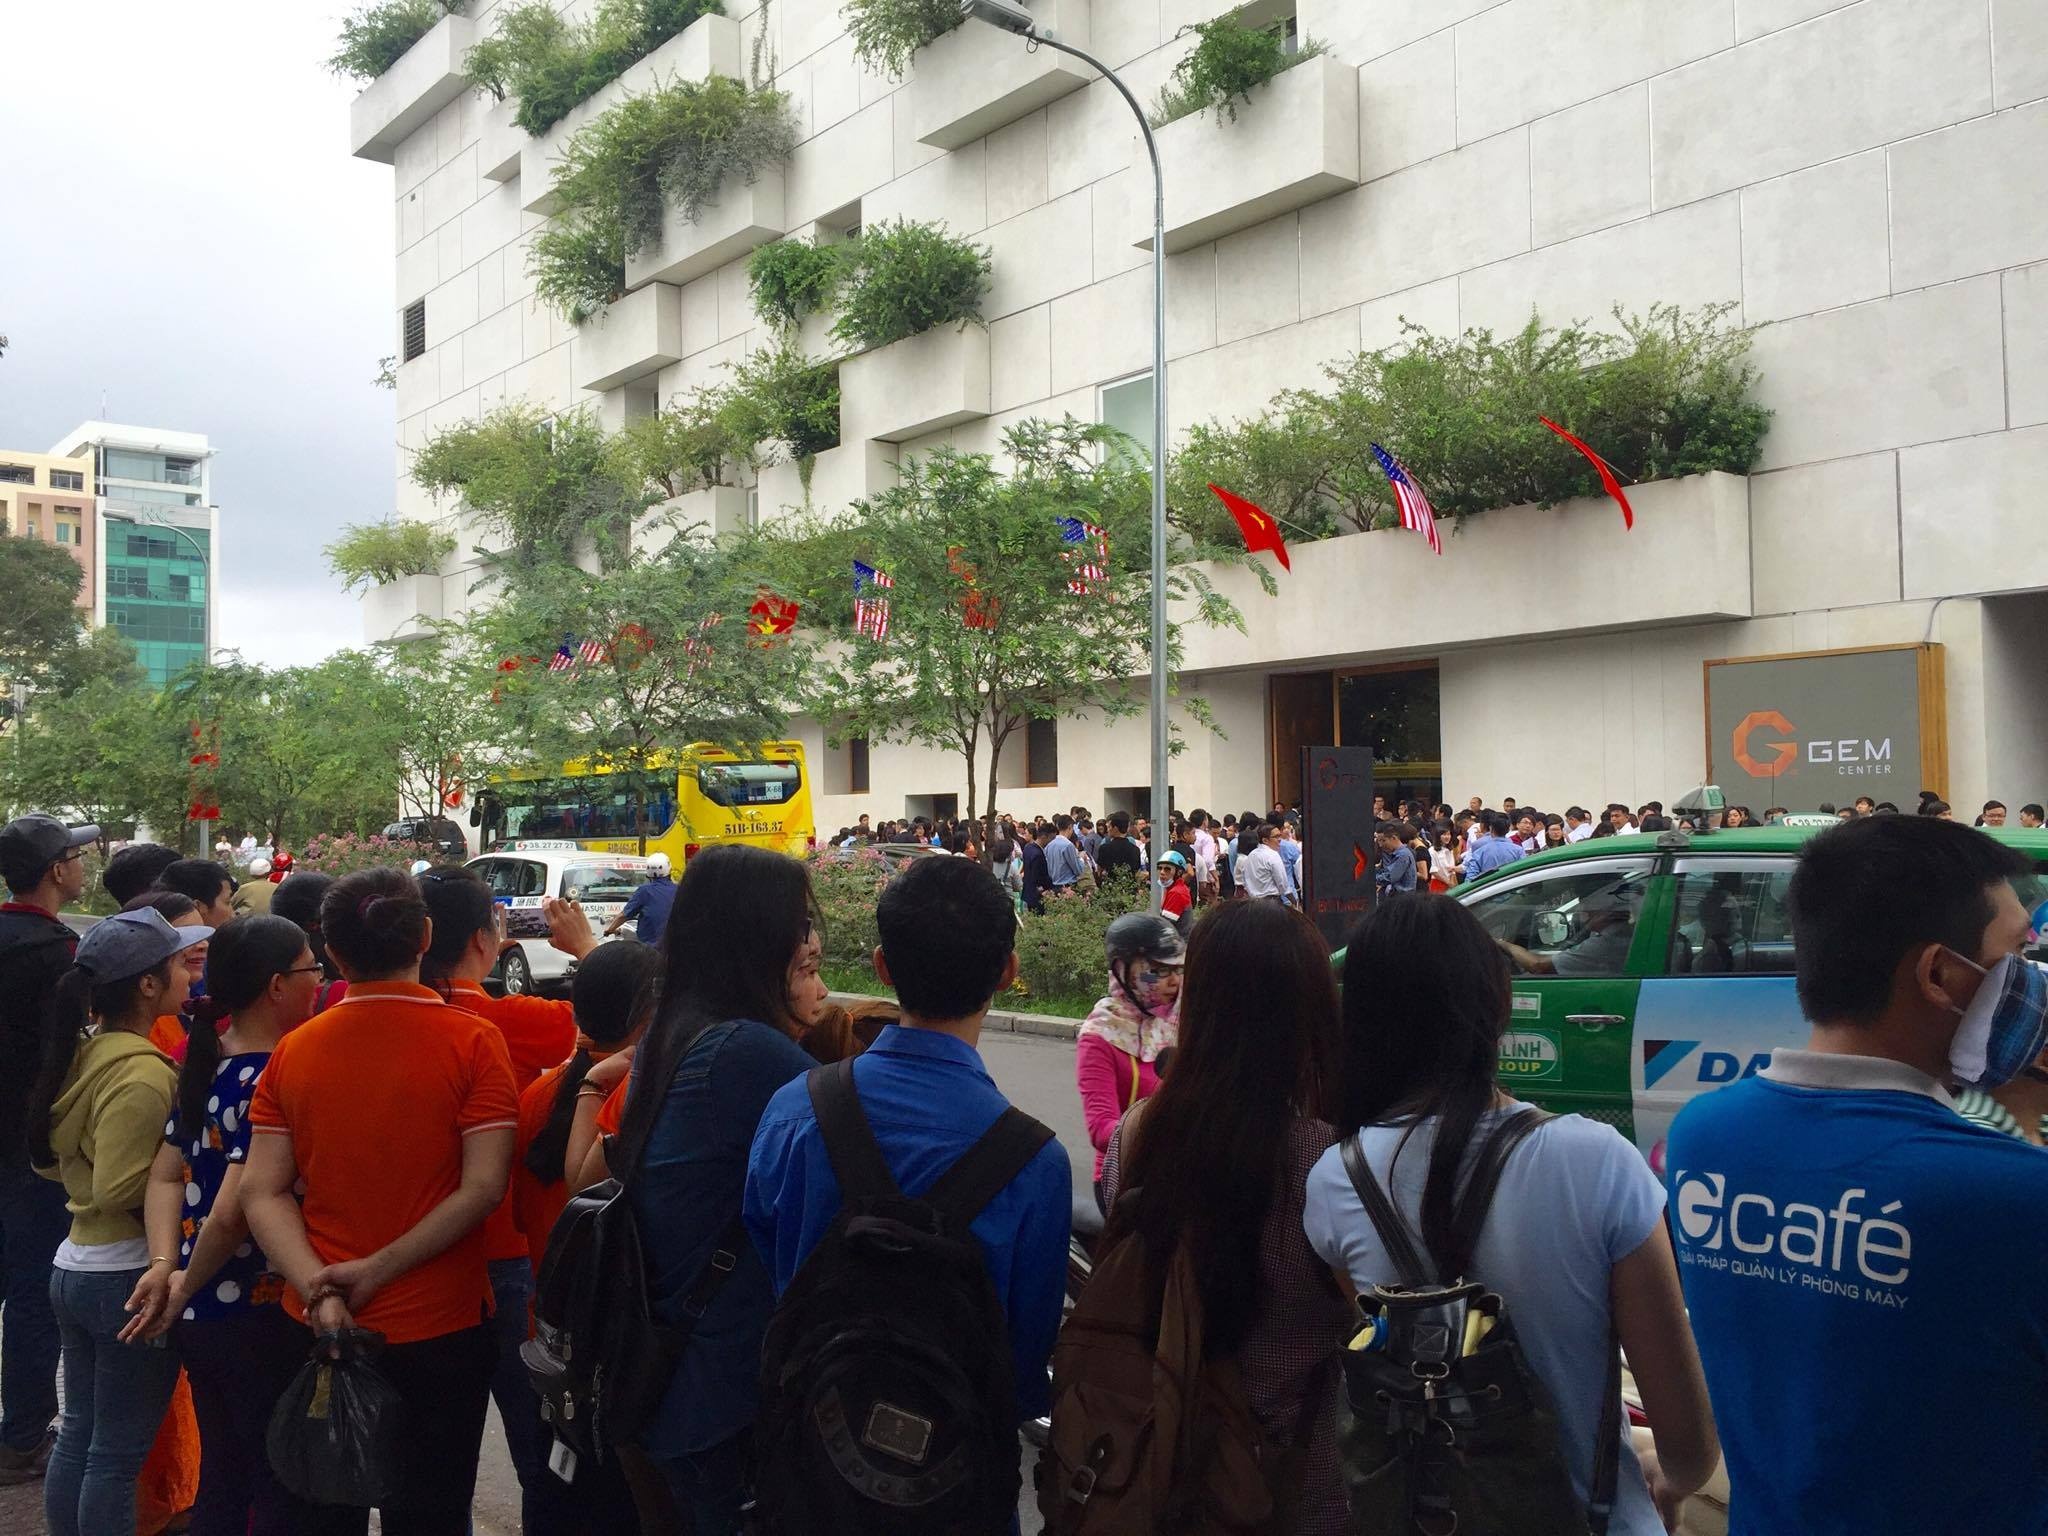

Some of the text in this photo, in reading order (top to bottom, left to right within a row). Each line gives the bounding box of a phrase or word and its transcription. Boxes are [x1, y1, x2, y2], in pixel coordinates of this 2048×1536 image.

[1808, 738, 1891, 763] GEM
[1838, 764, 1892, 776] CENTER
[724, 821, 784, 834] 51B-163.37
[1779, 1261, 1797, 1284] LÝ
[1801, 1273, 1859, 1299] PHÒNG
[1865, 1287, 1909, 1309] MÁY
